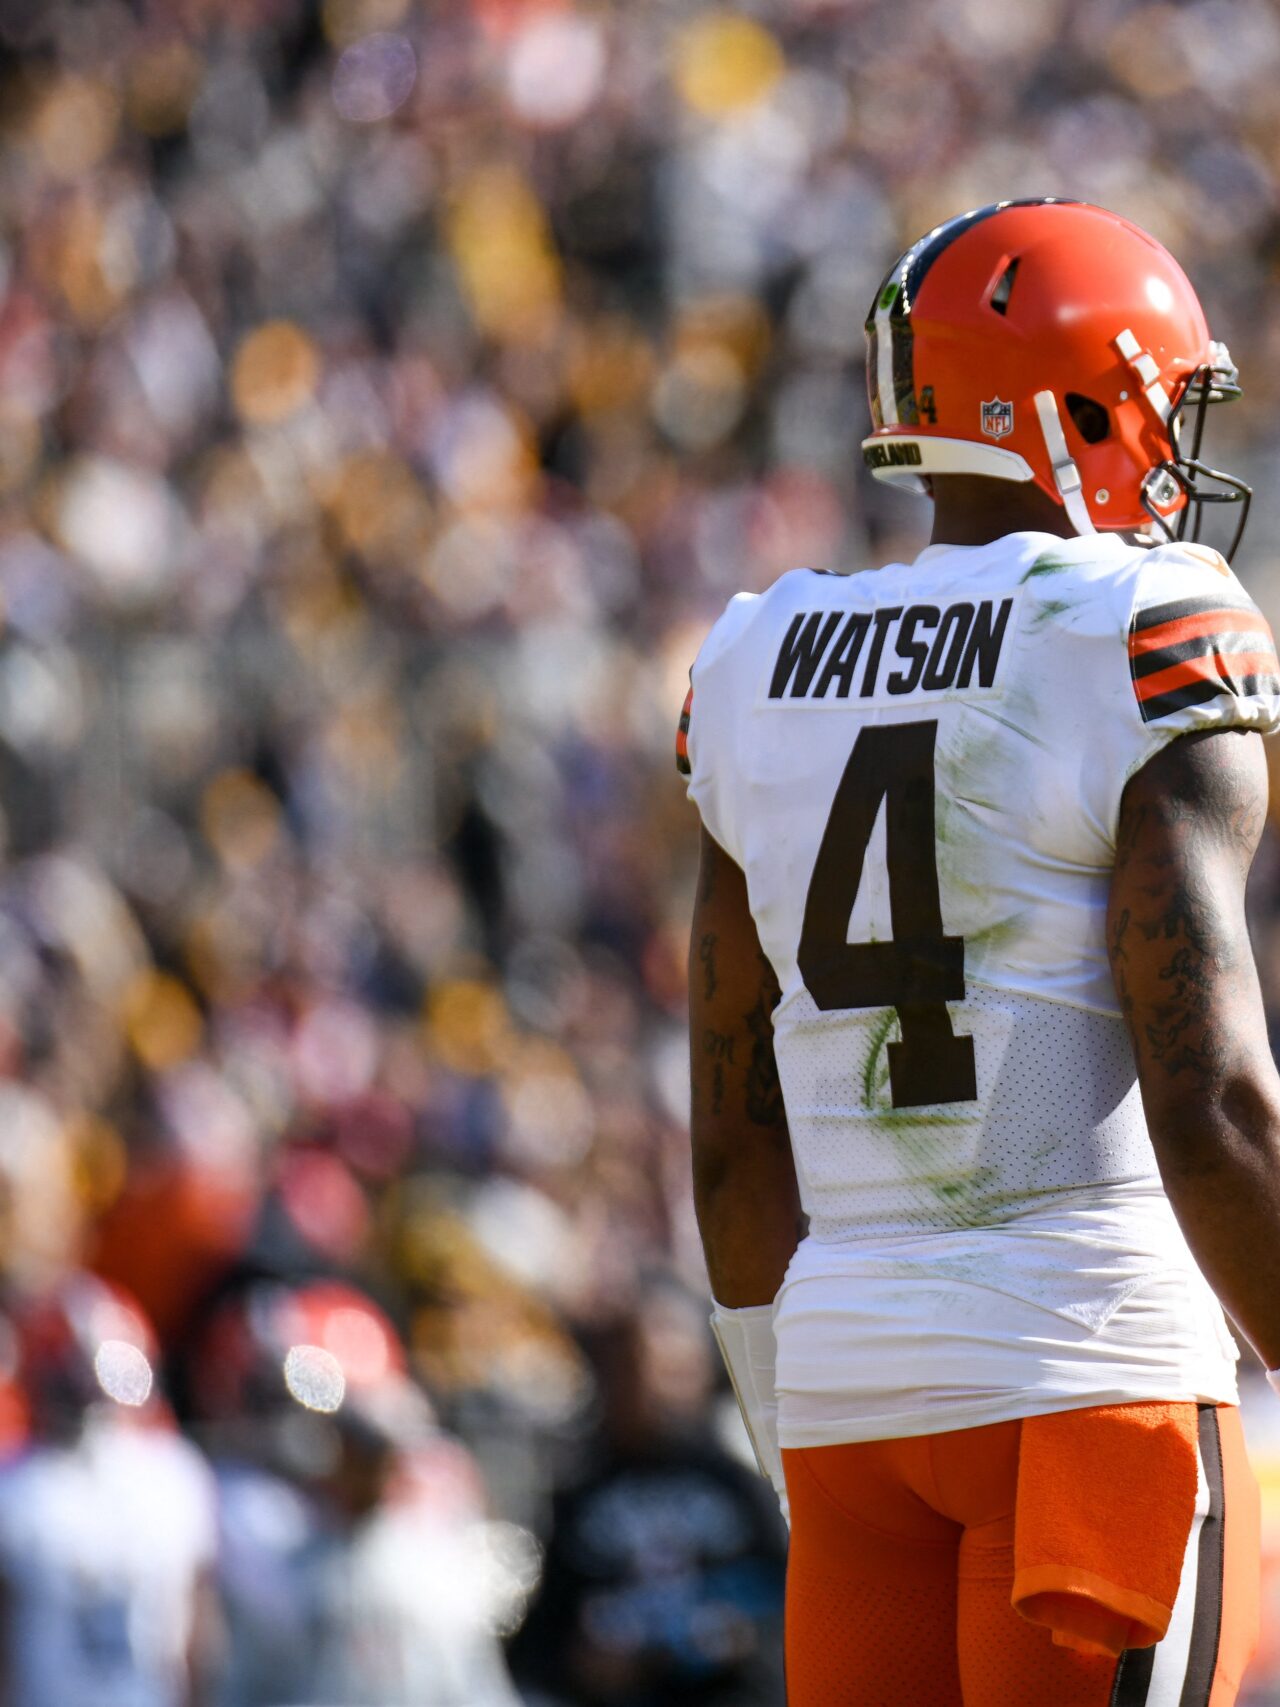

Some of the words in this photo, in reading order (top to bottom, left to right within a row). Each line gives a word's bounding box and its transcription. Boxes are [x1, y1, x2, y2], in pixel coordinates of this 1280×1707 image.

[985, 415, 1009, 431] NFL
[768, 598, 1013, 699] WATSON
[797, 719, 977, 1108] 4
